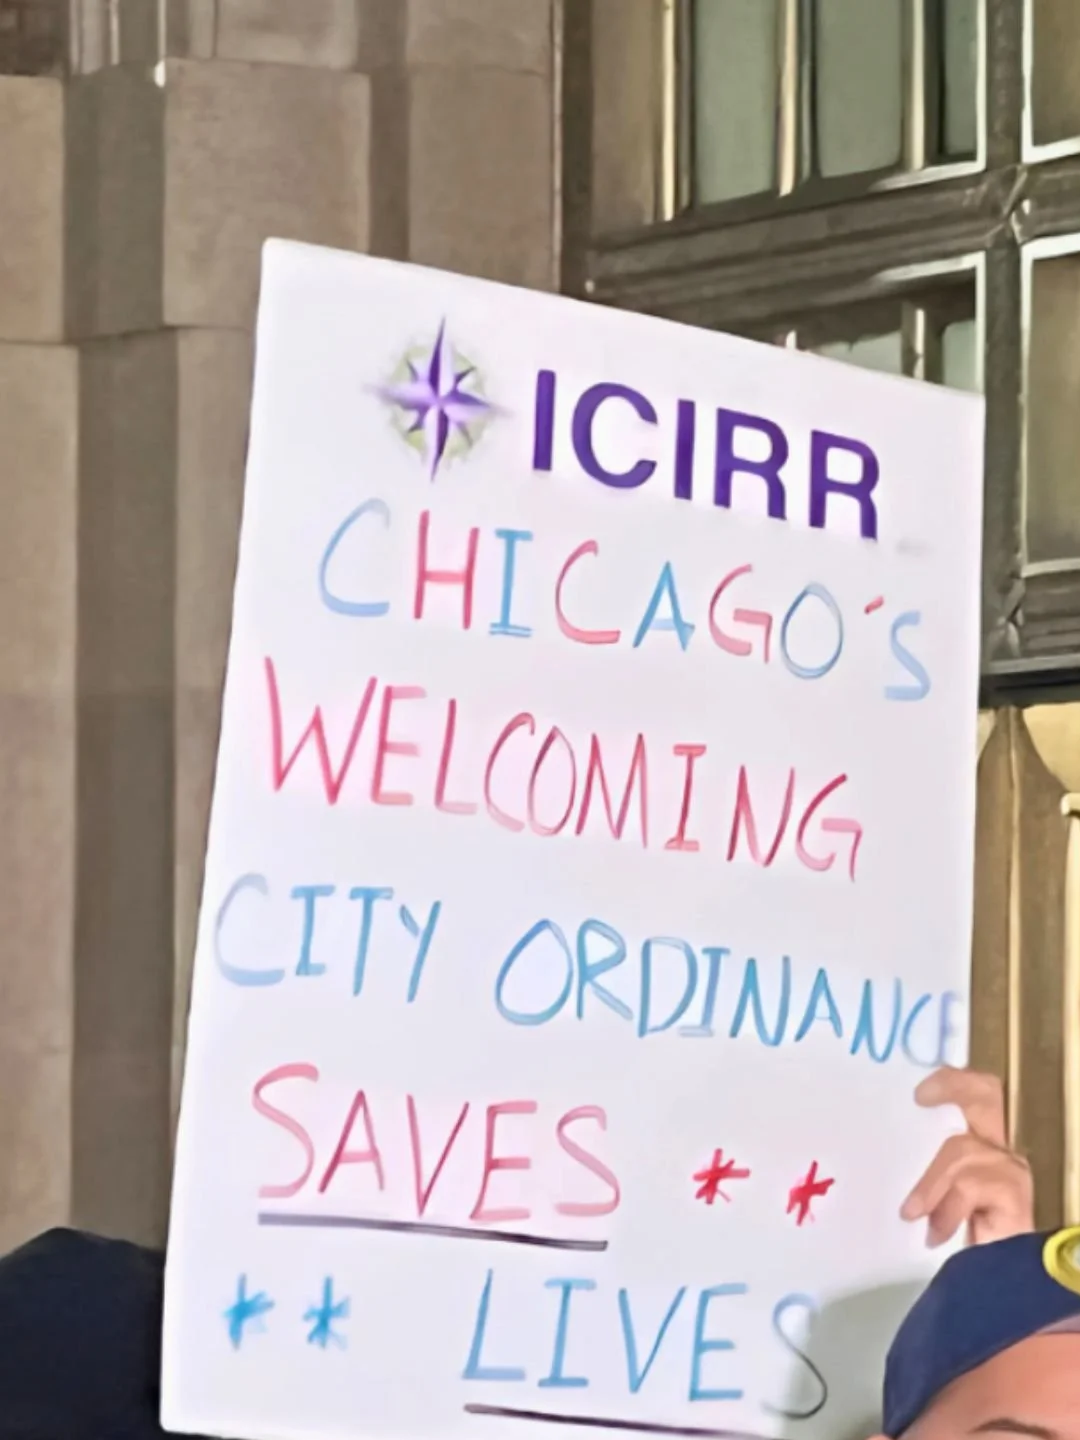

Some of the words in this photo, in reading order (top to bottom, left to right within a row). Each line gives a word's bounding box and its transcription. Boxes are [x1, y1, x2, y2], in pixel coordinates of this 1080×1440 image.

[532, 369, 881, 541] ICIRR
[318, 497, 932, 702] CHICAGO'S
[264, 656, 863, 881] WELCOMING
[213, 872, 442, 1003] CITY
[493, 918, 963, 1068] ORDINANCE
[251, 1062, 621, 1222] SAVES
[460, 1268, 828, 1419] LIVES
